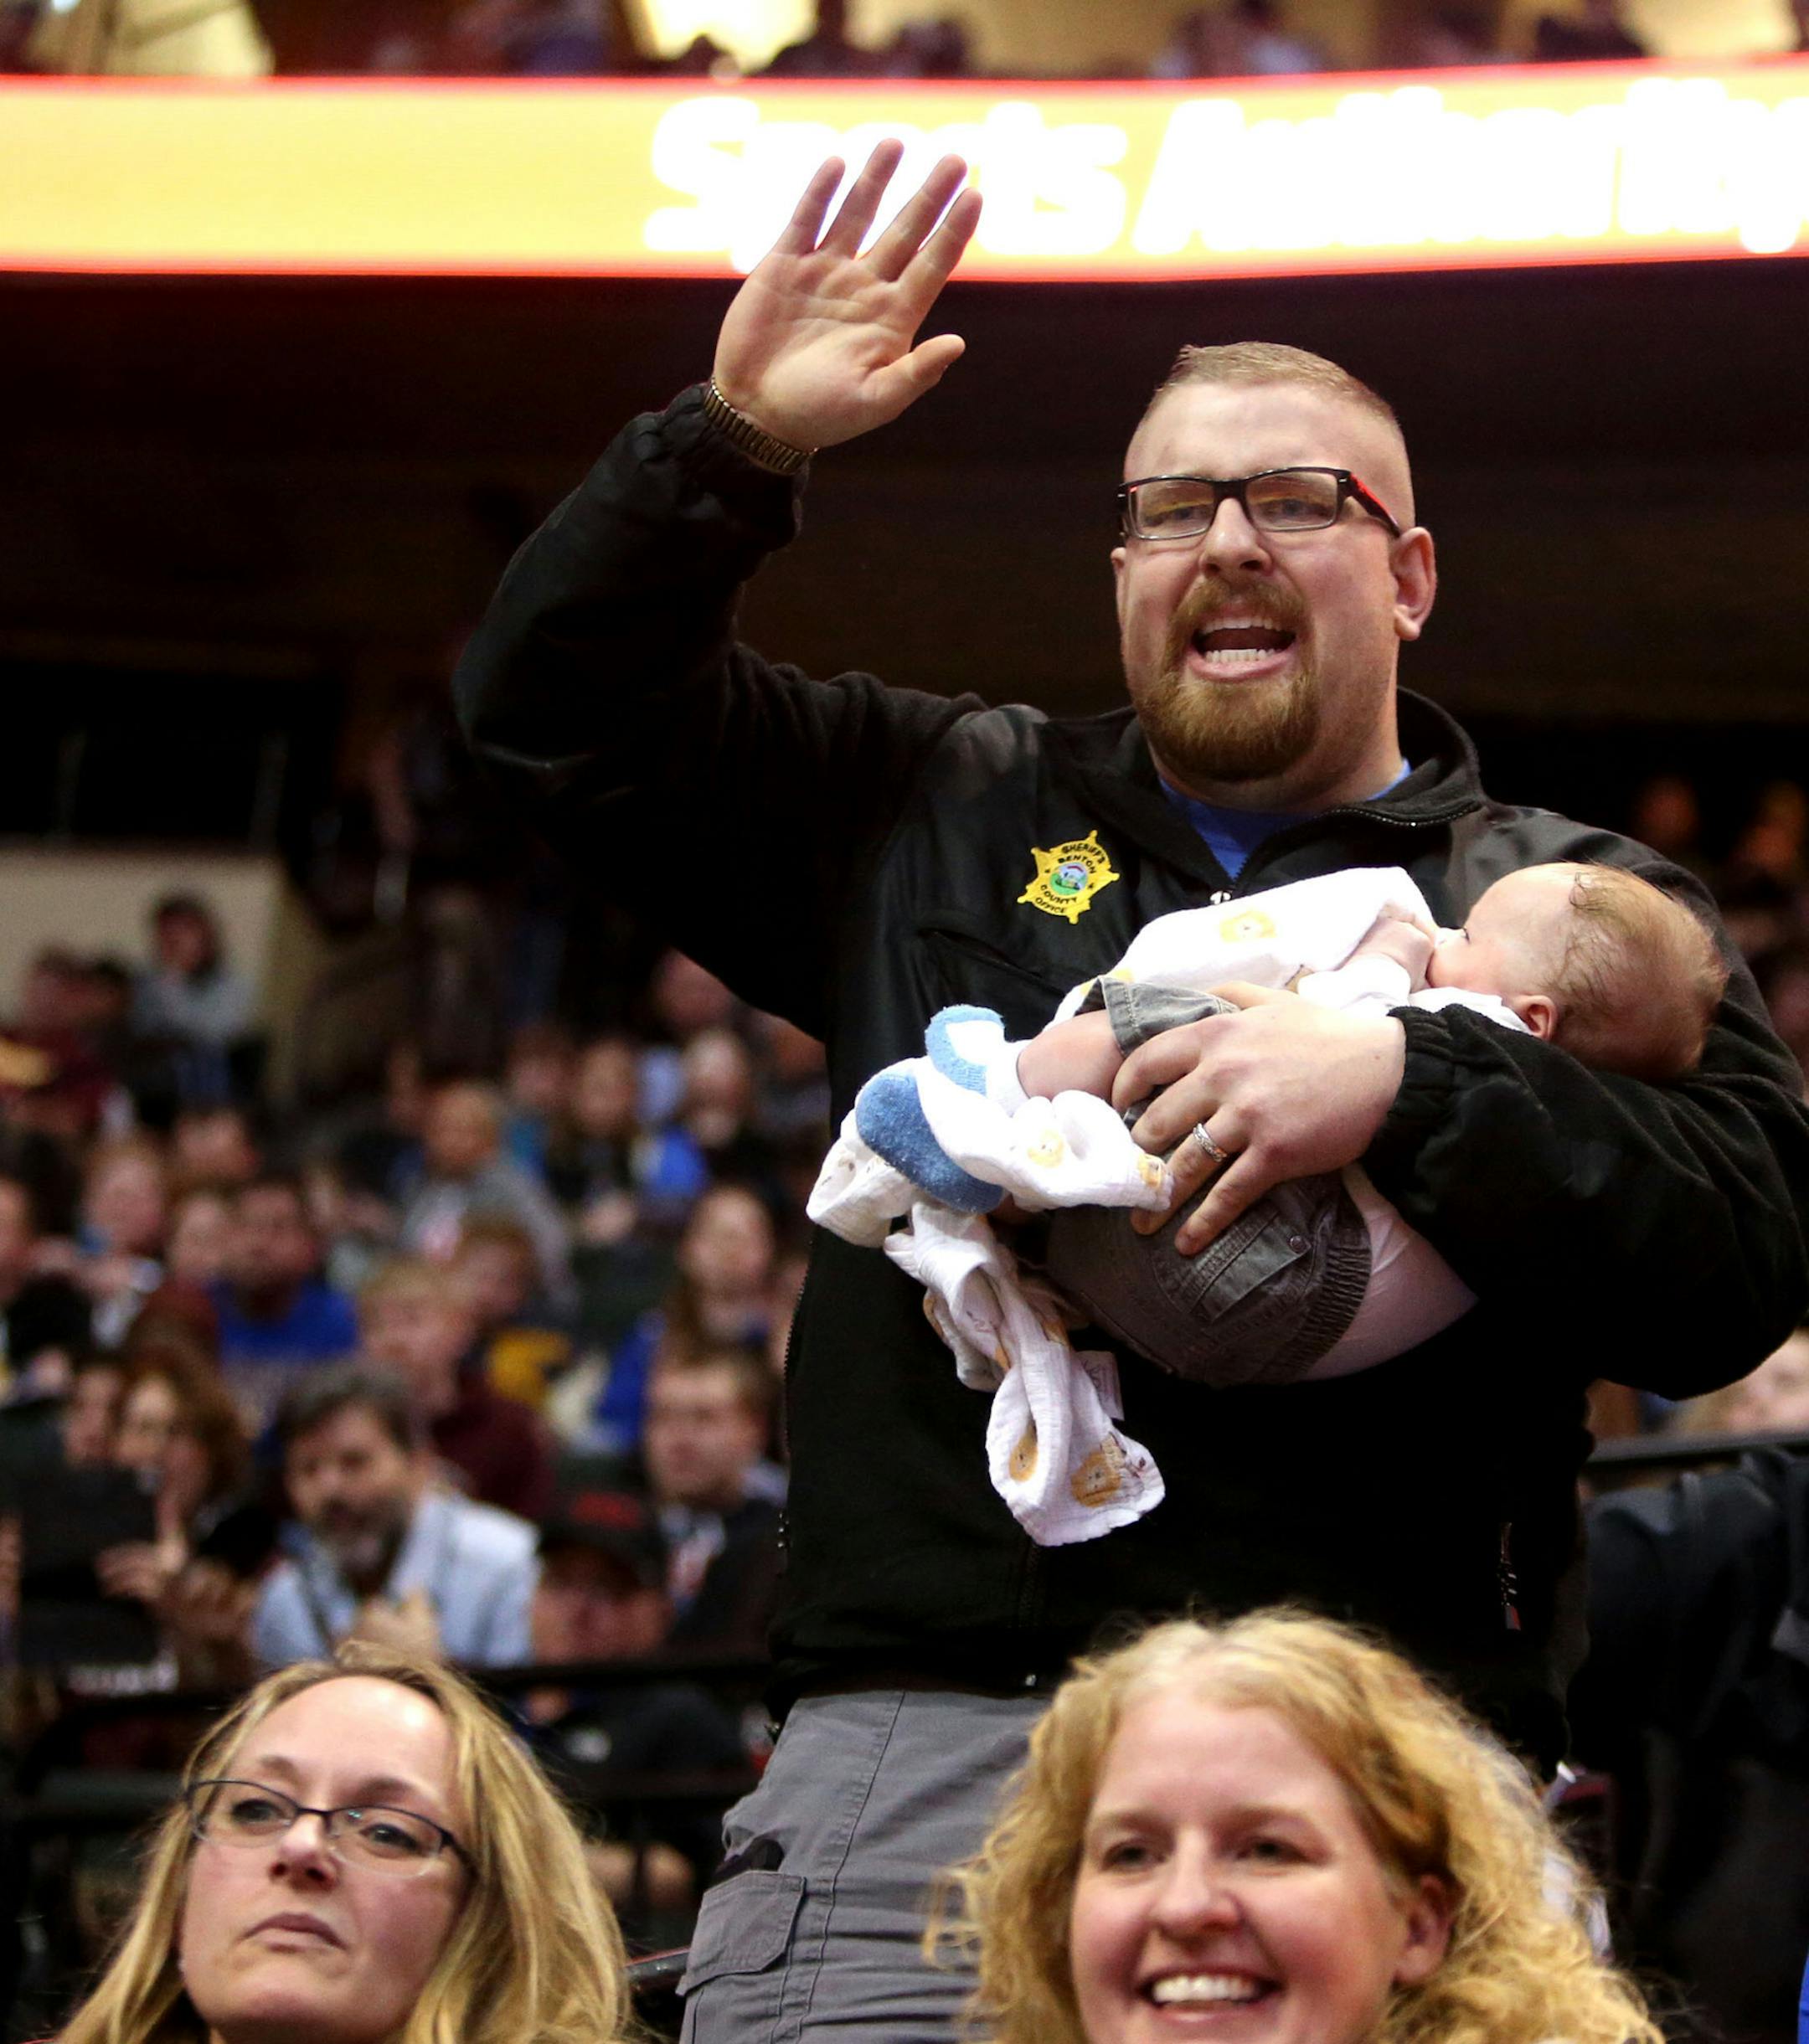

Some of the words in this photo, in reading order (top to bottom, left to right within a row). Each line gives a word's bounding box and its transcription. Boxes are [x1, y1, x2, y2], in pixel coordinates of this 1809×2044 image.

[1058, 855, 1096, 873] BENTON
[1040, 884, 1077, 904] COUNTY
[1035, 897, 1065, 913] OFFICE
